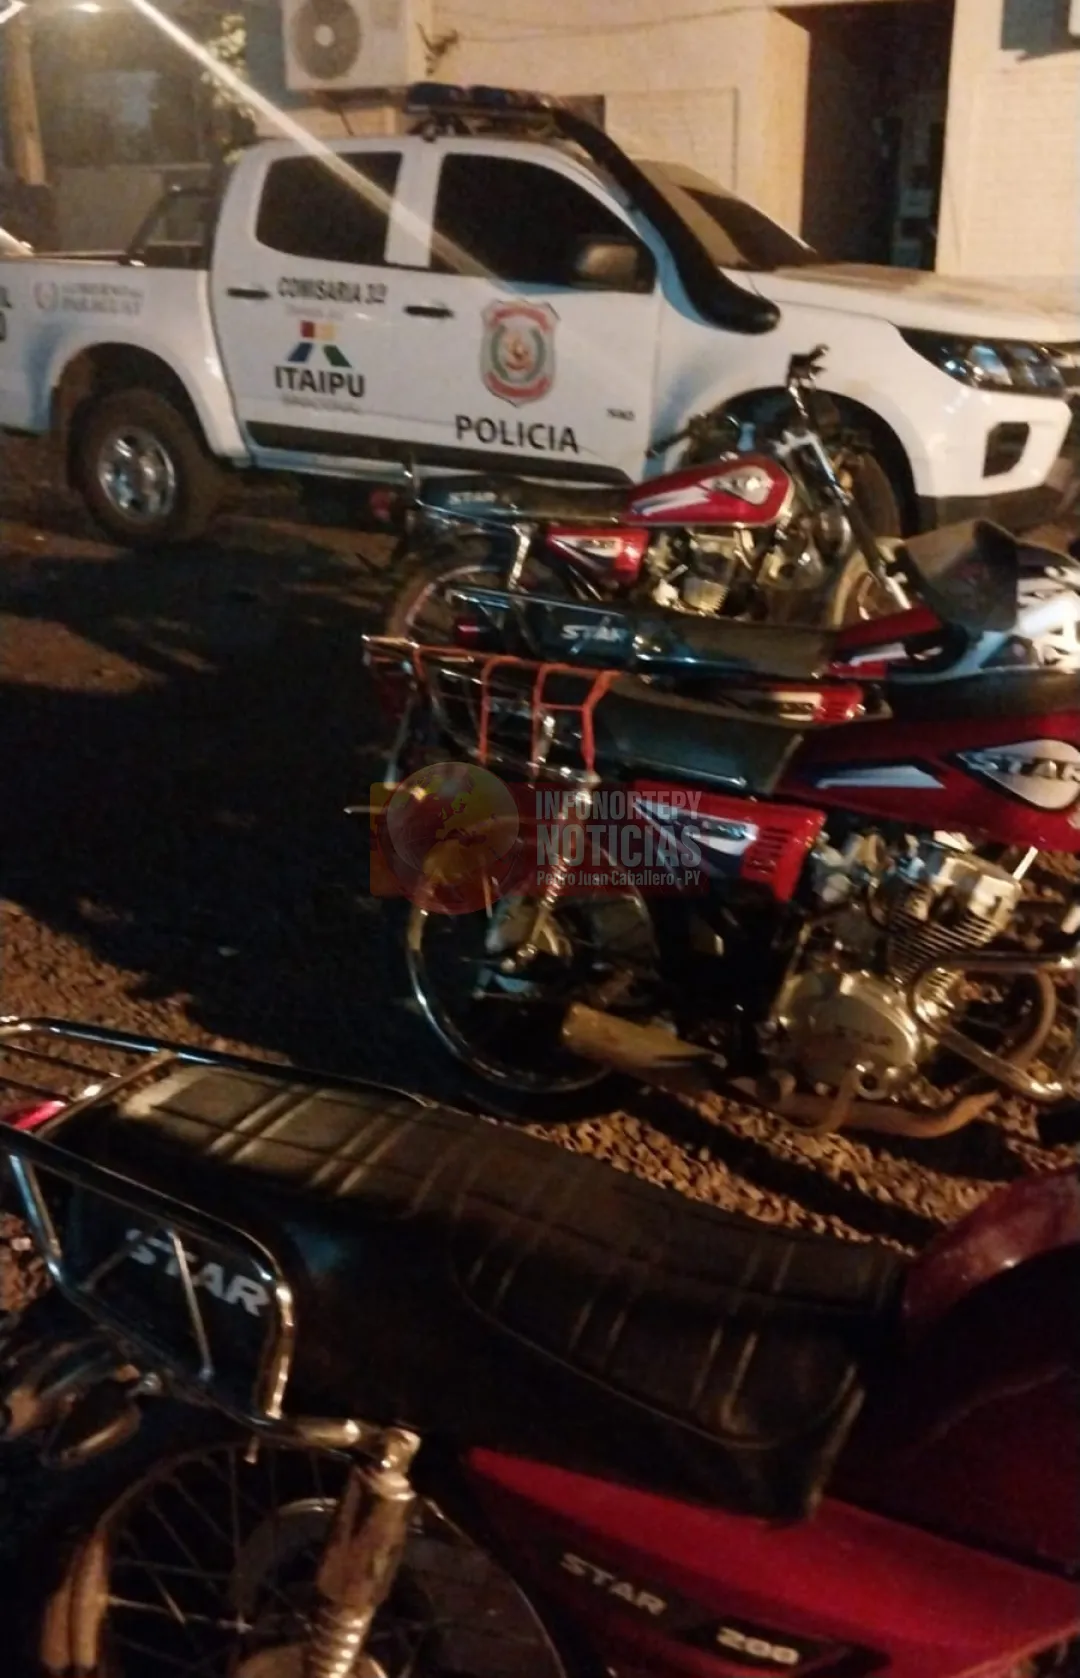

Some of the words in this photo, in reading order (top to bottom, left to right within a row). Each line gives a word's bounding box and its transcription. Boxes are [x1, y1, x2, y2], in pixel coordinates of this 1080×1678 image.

[278, 276, 361, 304] COMISARIA
[274, 365, 366, 399] ITAIPU
[455, 414, 580, 454] POLICIA
[125, 1228, 270, 1317] STAR
[560, 1552, 667, 1616] STAR
